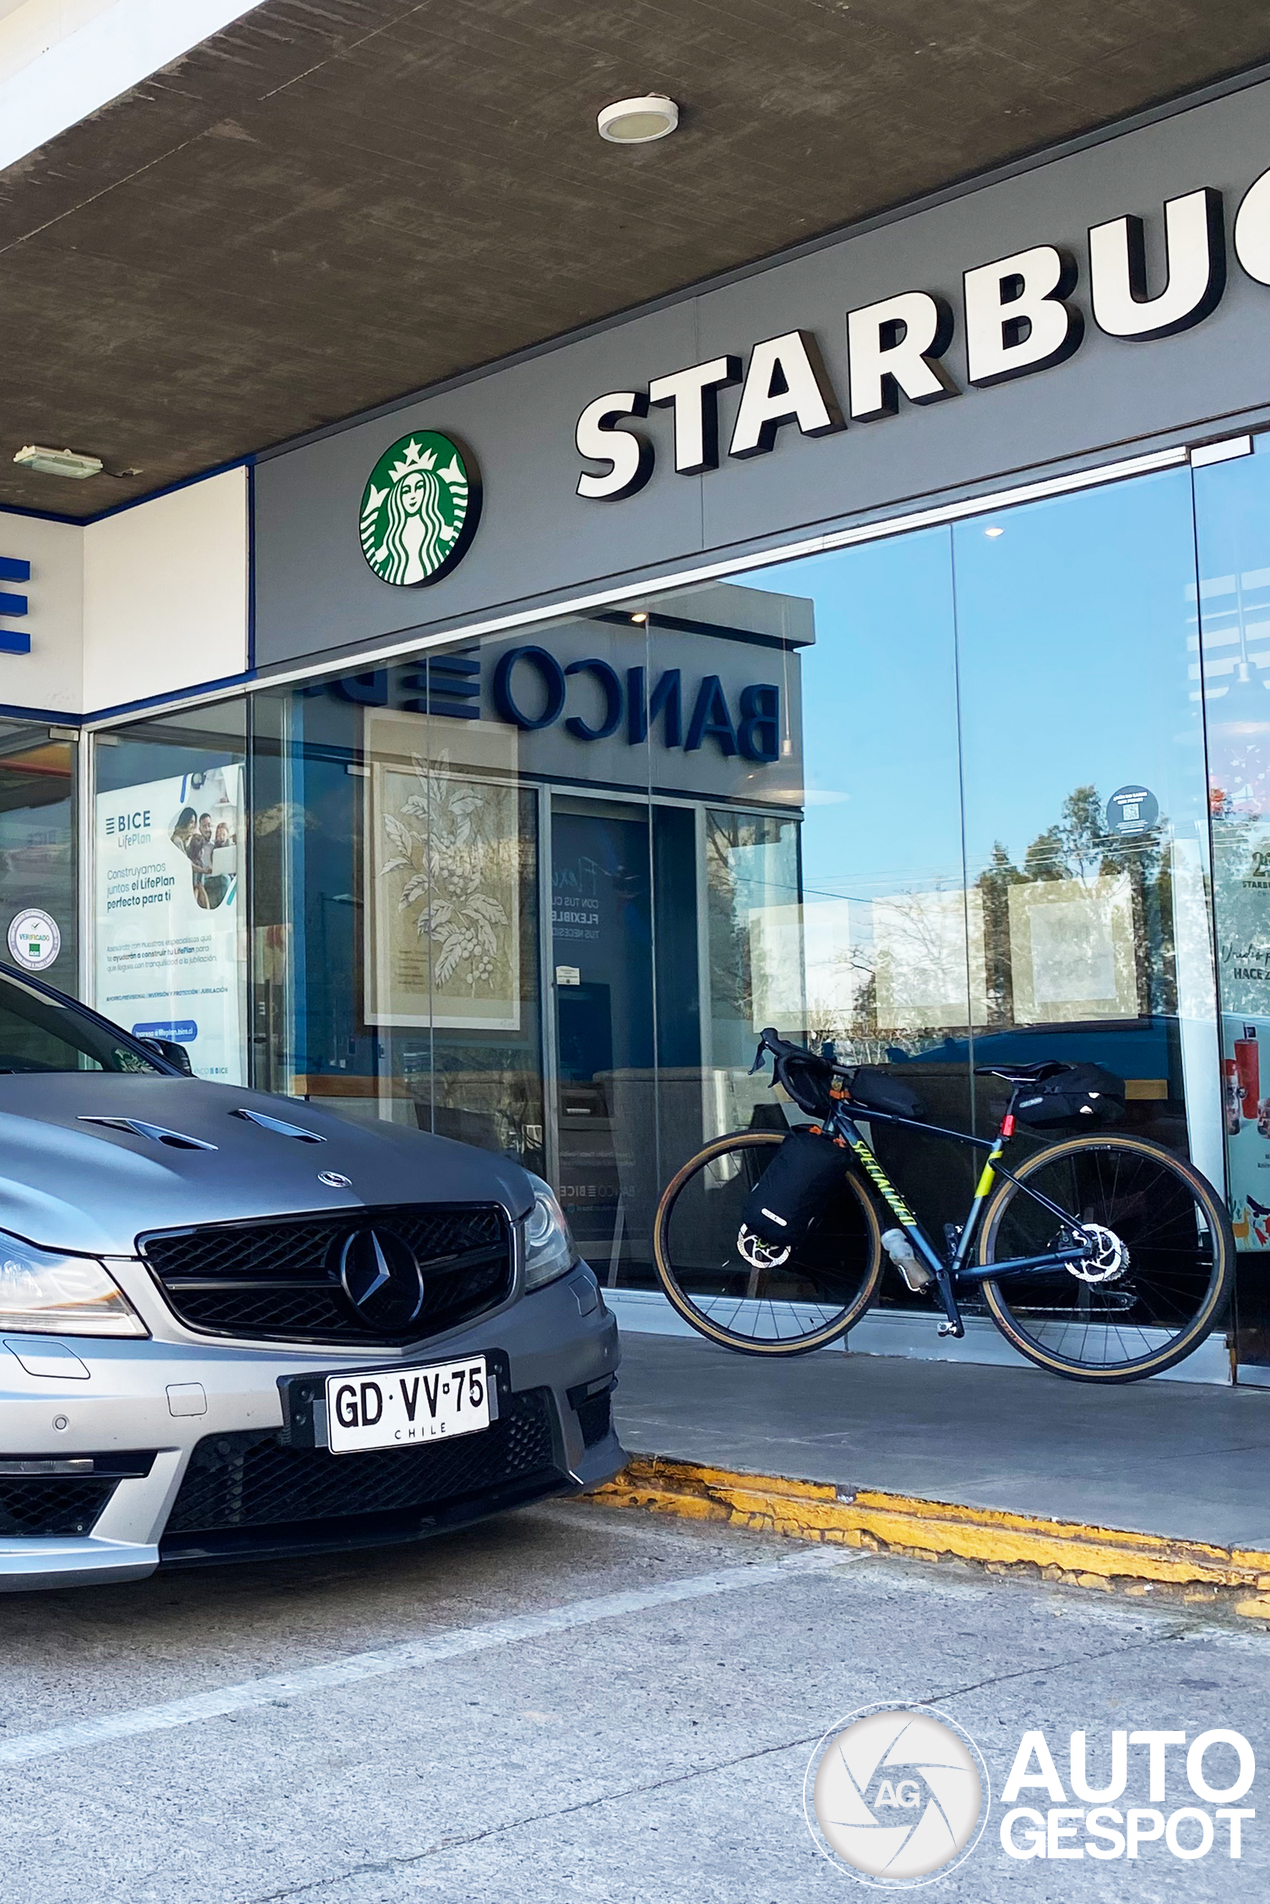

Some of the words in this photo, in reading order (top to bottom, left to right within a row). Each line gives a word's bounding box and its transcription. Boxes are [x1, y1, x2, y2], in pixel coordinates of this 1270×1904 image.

[118, 810, 151, 832] BICE
[118, 833, 151, 849] LifePlan
[107, 862, 167, 881] Construyamos
[107, 881, 130, 898] juntos
[131, 880, 139, 891] el
[140, 876, 175, 889] LifePlan
[1242, 880, 1270, 889] STARB
[107, 895, 141, 913] perfecto
[142, 893, 163, 908] para
[164, 890, 171, 901] ti
[141, 948, 167, 958] construir
[174, 946, 195, 954] LifePlan
[144, 957, 179, 968] tranquilidad
[1234, 967, 1263, 980] HACE
[852, 1140, 917, 1226] SPECIALIZED
[394, 1422, 446, 1440] CHILE
